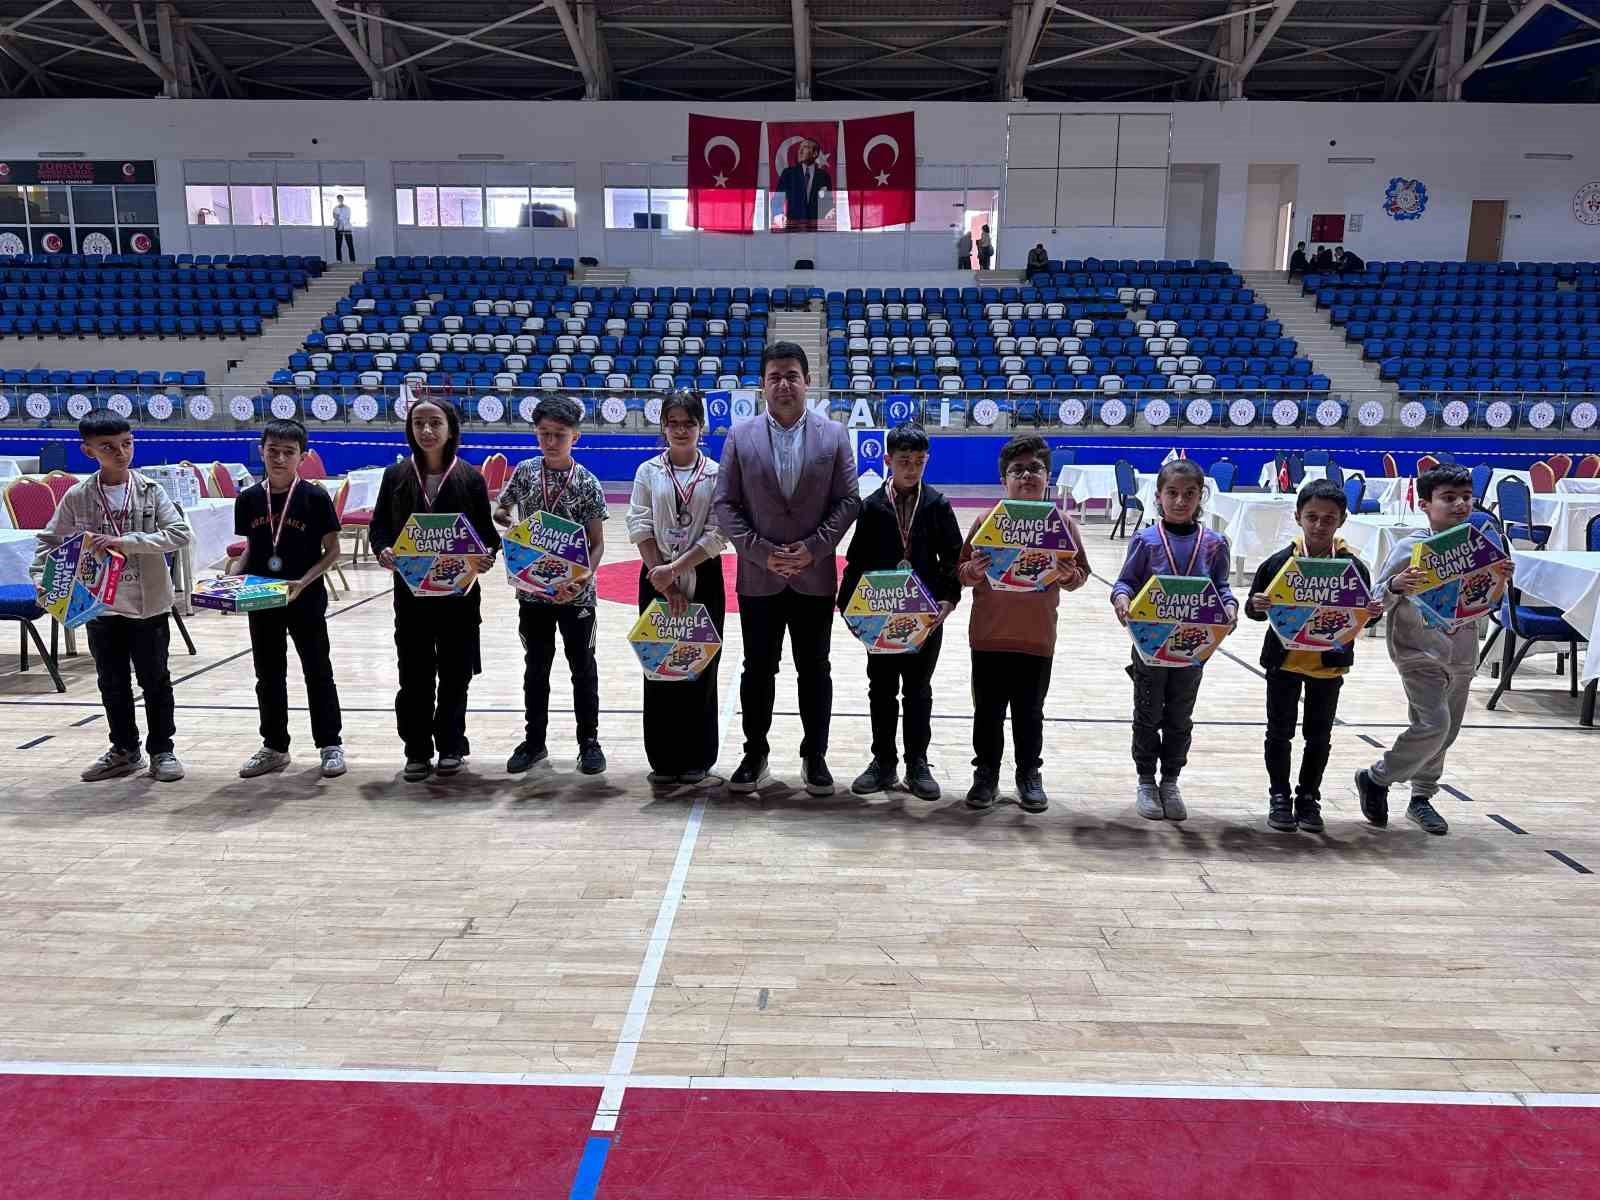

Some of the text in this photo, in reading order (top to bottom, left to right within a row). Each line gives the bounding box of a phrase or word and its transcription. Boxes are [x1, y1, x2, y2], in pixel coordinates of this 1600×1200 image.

[993, 513, 1061, 533] TRIANGLE
[406, 526, 468, 540] TRIANGLE
[528, 518, 585, 549] TRIANGLE
[1002, 530, 1044, 545] GAME
[416, 539, 455, 551] GAME
[530, 533, 568, 555] GAME
[1422, 536, 1486, 569] TRIANGLE
[1436, 554, 1477, 579] GAME
[43, 548, 68, 608] TRIANGLE
[58, 561, 75, 598] GAME
[1285, 571, 1359, 590] TRIANGLE
[858, 585, 919, 600] TRIANGLE
[1149, 589, 1217, 607] TRIANGLE
[1294, 588, 1341, 602] GAME
[868, 597, 906, 611] GAME
[1156, 605, 1200, 620] GAME
[649, 612, 709, 628] TRIANGLE
[657, 624, 694, 639] GAME
